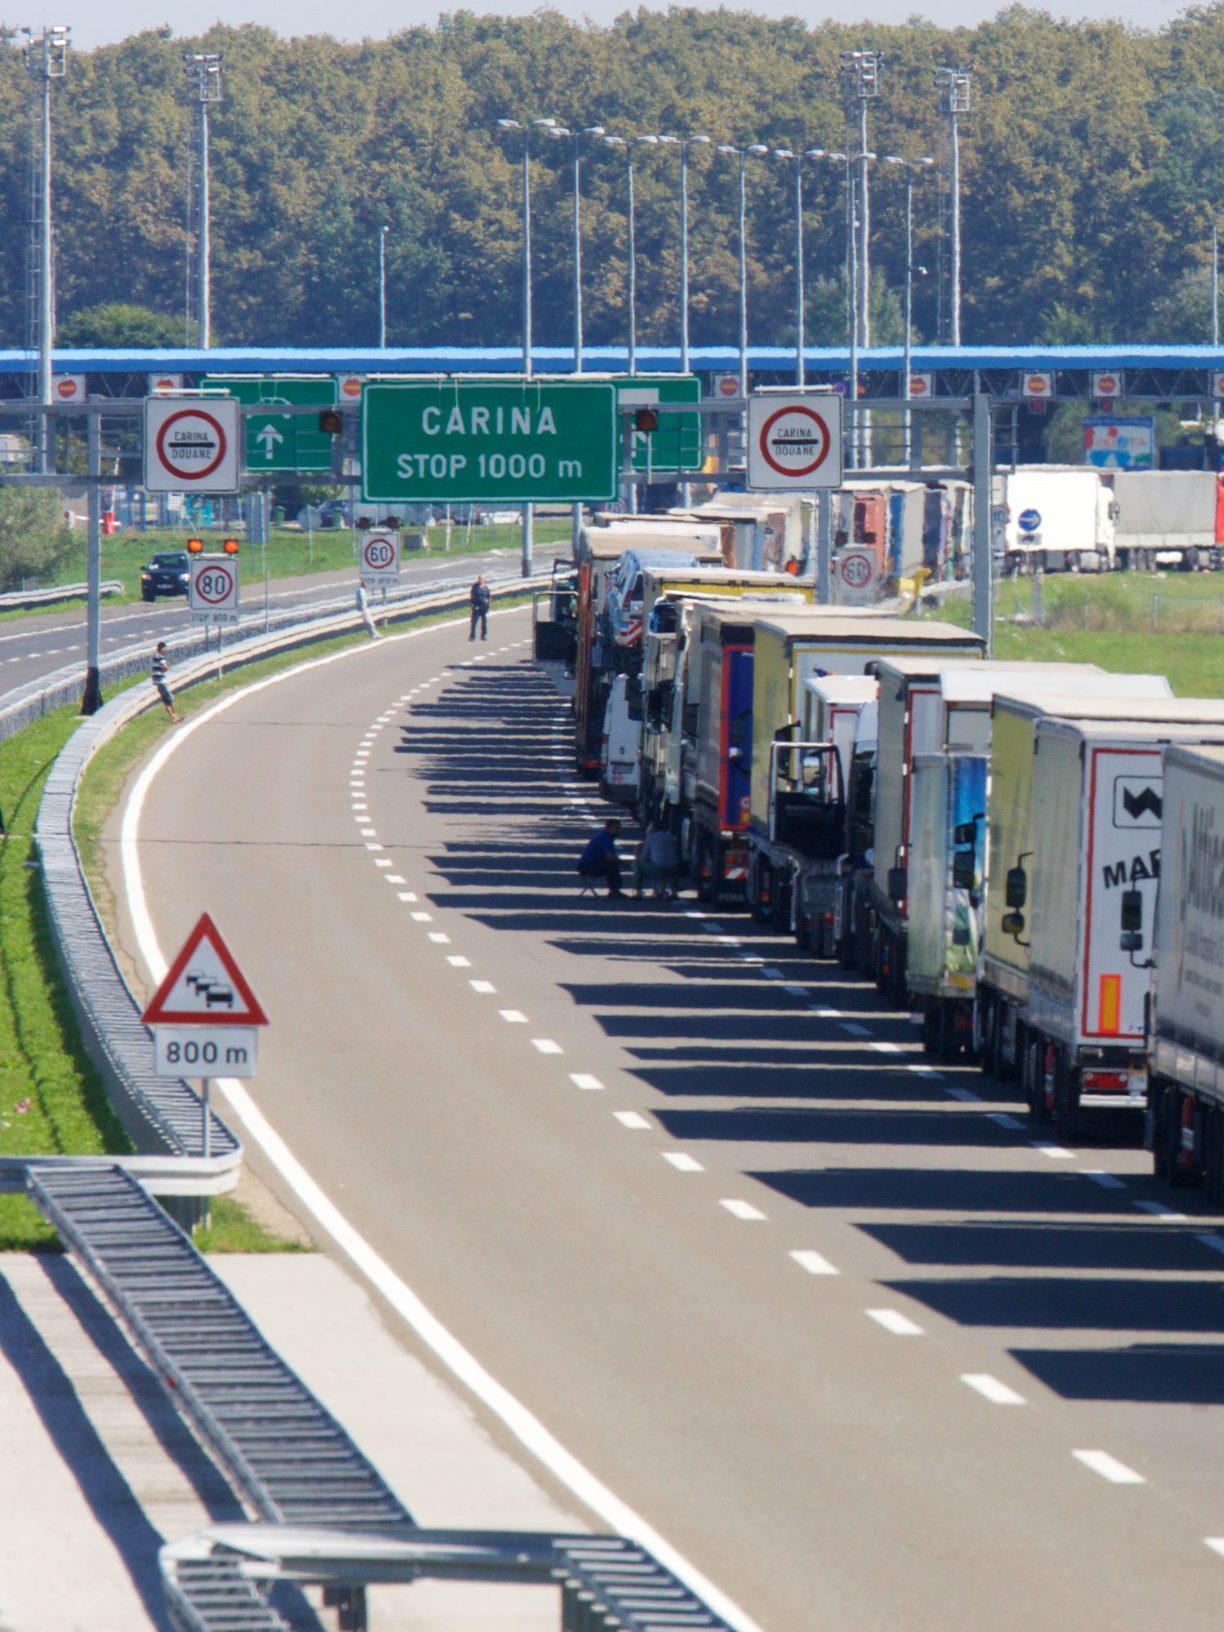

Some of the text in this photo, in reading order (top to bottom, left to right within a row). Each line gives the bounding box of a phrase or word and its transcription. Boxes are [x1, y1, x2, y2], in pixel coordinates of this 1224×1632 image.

[422, 406, 557, 435] CARINA
[174, 431, 208, 441] CARINA
[777, 428, 812, 438] CARINA
[172, 449, 212, 459] DOUANE
[774, 446, 815, 456] DOUANE
[397, 454, 582, 479] STOP 1000 m
[370, 546, 388, 562] 60
[203, 575, 225, 595] 80
[166, 1041, 248, 1064] 800 m
